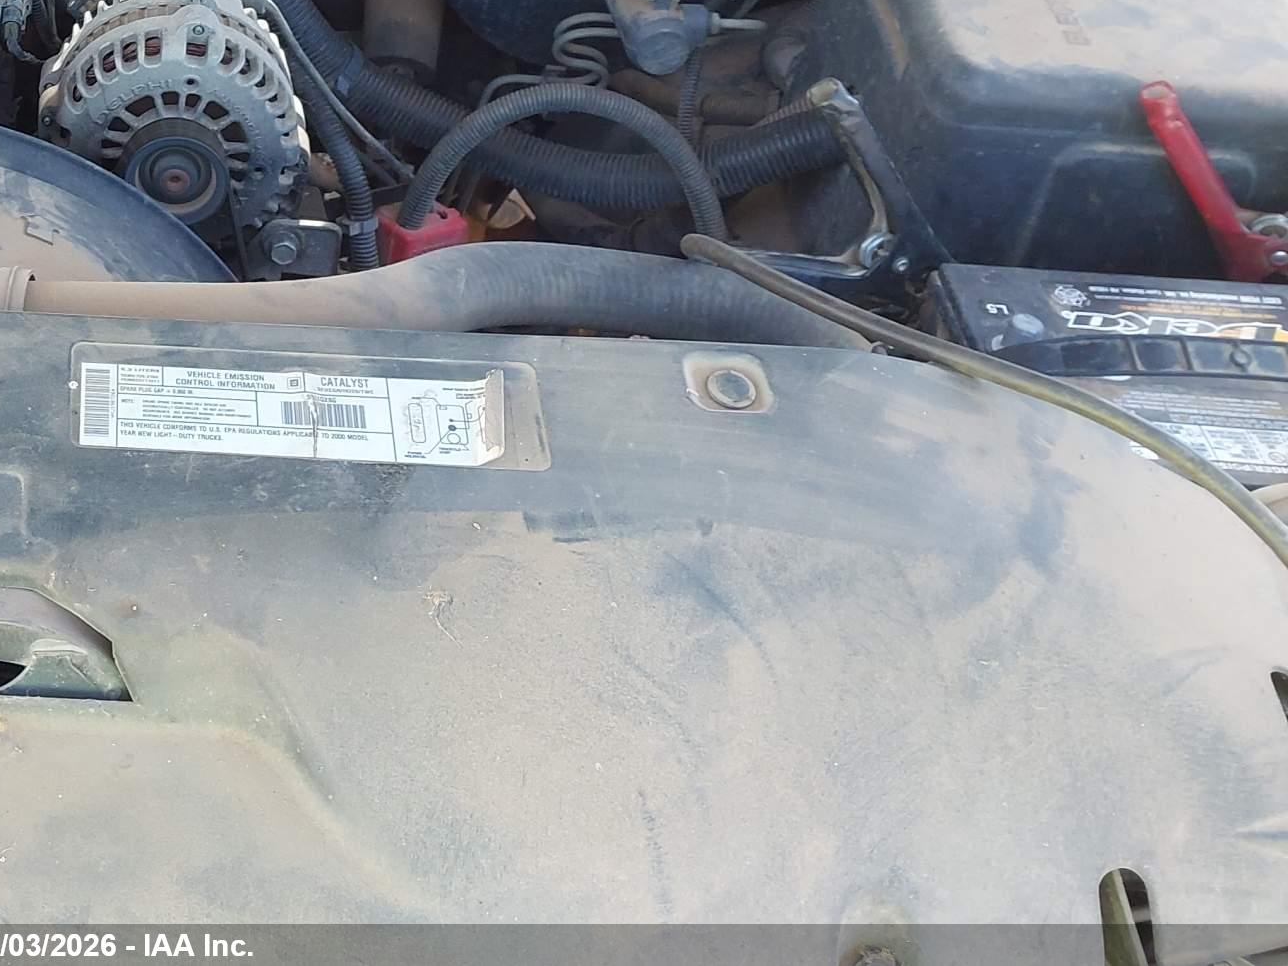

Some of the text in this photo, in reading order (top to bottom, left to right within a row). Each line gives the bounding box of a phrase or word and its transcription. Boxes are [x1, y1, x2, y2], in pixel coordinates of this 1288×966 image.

[187, 370, 265, 381] VEHICLE EMISSION
[176, 378, 276, 390] CONTROL INFORMATION
[320, 377, 368, 388] CATALYST
[136, 422, 160, 430] VEHICLE
